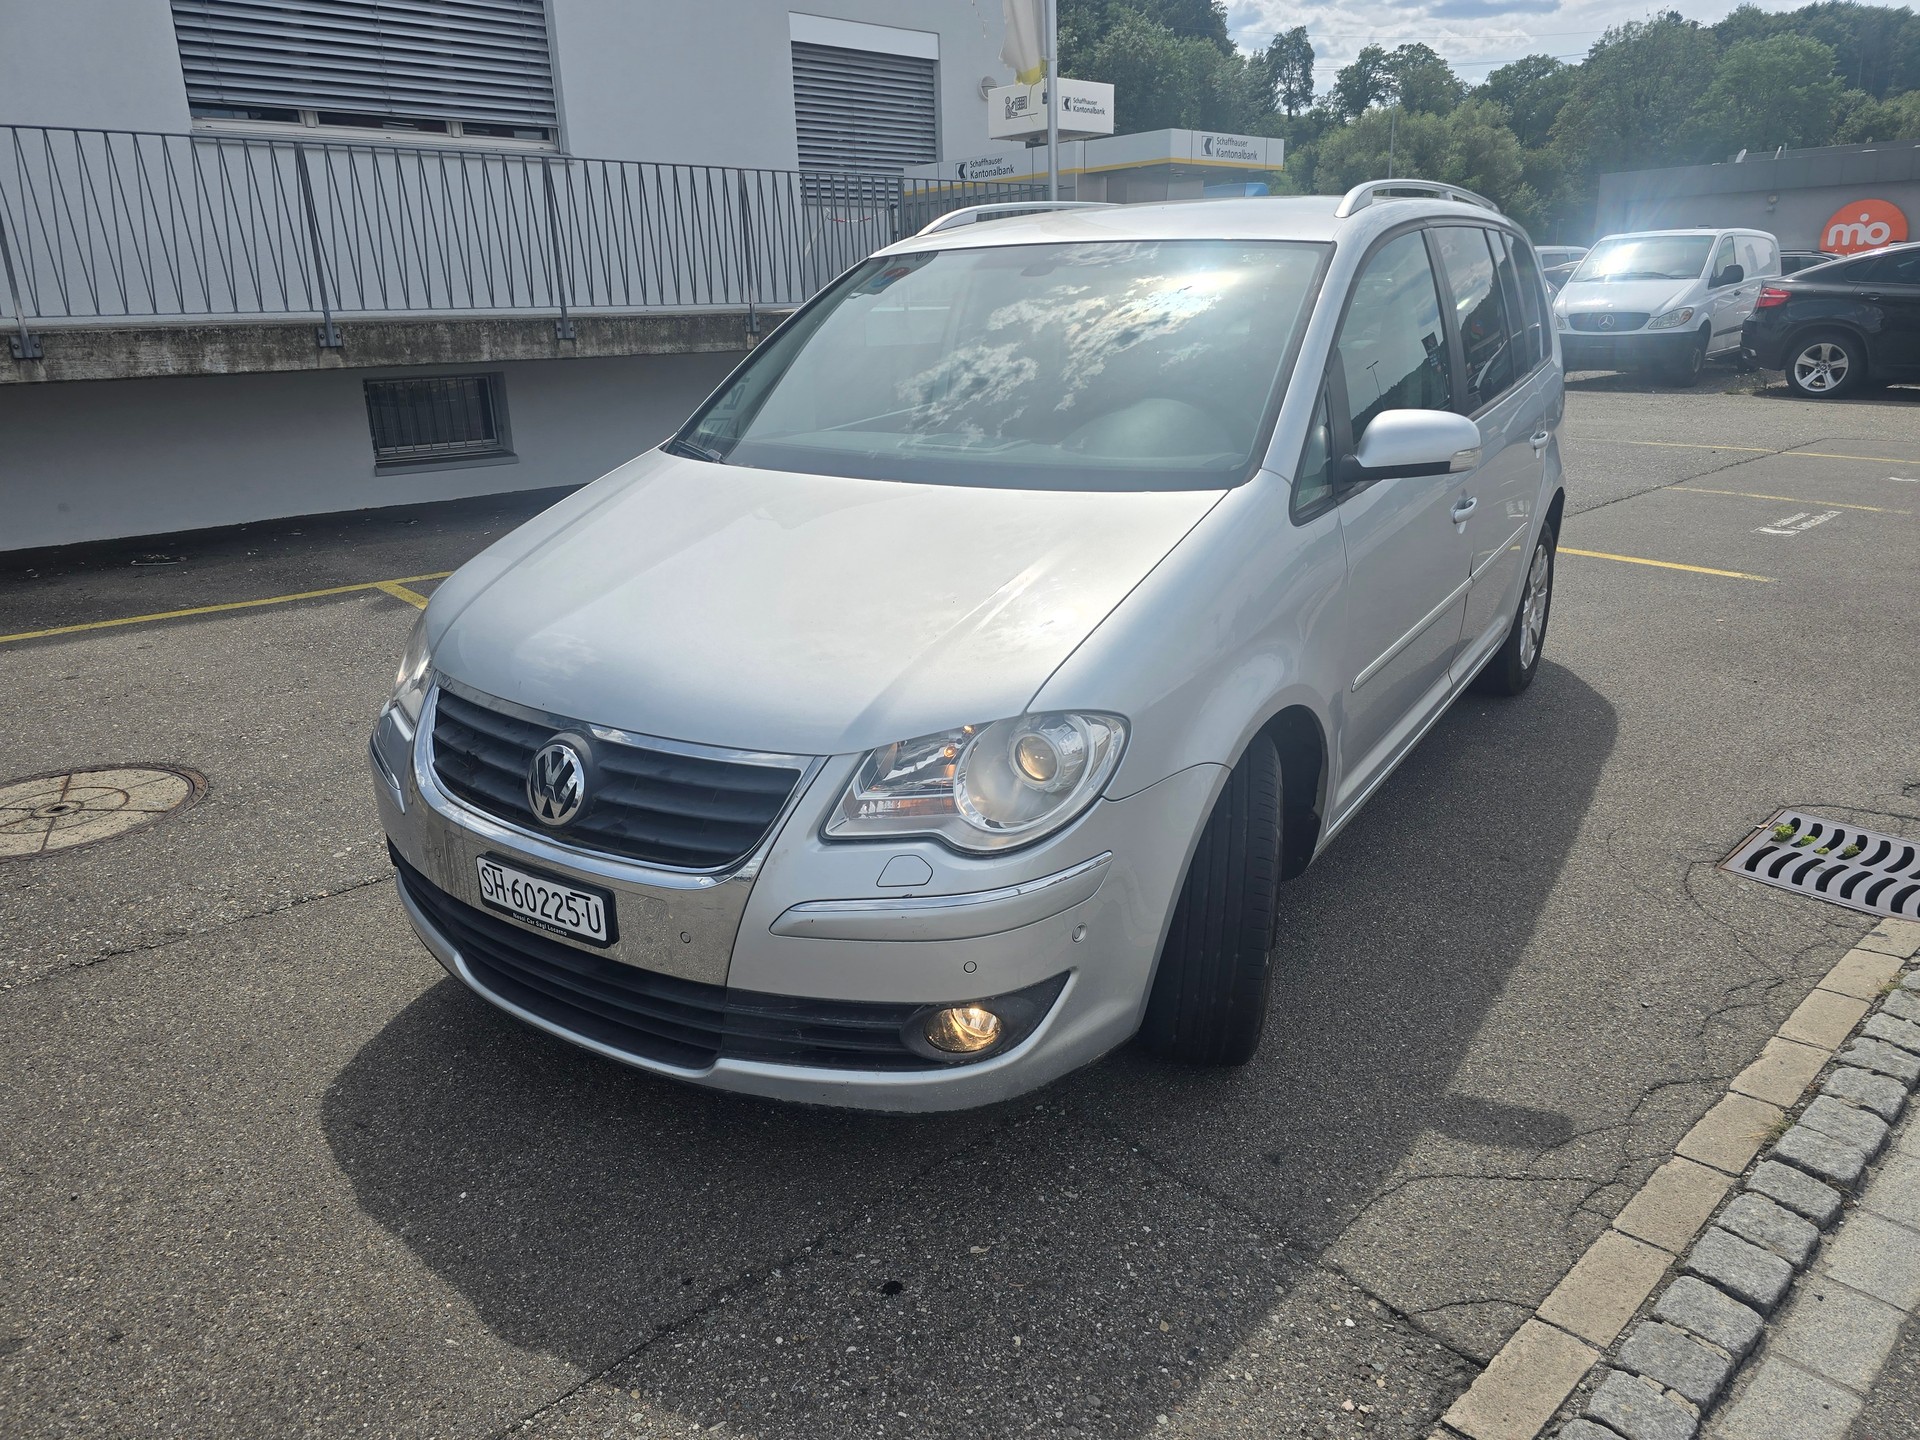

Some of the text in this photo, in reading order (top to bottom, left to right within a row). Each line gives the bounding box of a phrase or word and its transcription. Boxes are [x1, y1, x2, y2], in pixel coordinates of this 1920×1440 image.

[1072, 105, 1105, 115] Kantonalbank
[1216, 136, 1249, 147] Schaffhauser
[1215, 147, 1258, 160] Kantonalbank
[969, 157, 1003, 168] Schaffhauser
[970, 164, 1015, 180] Kantonalbank
[1827, 213, 1891, 247] mio
